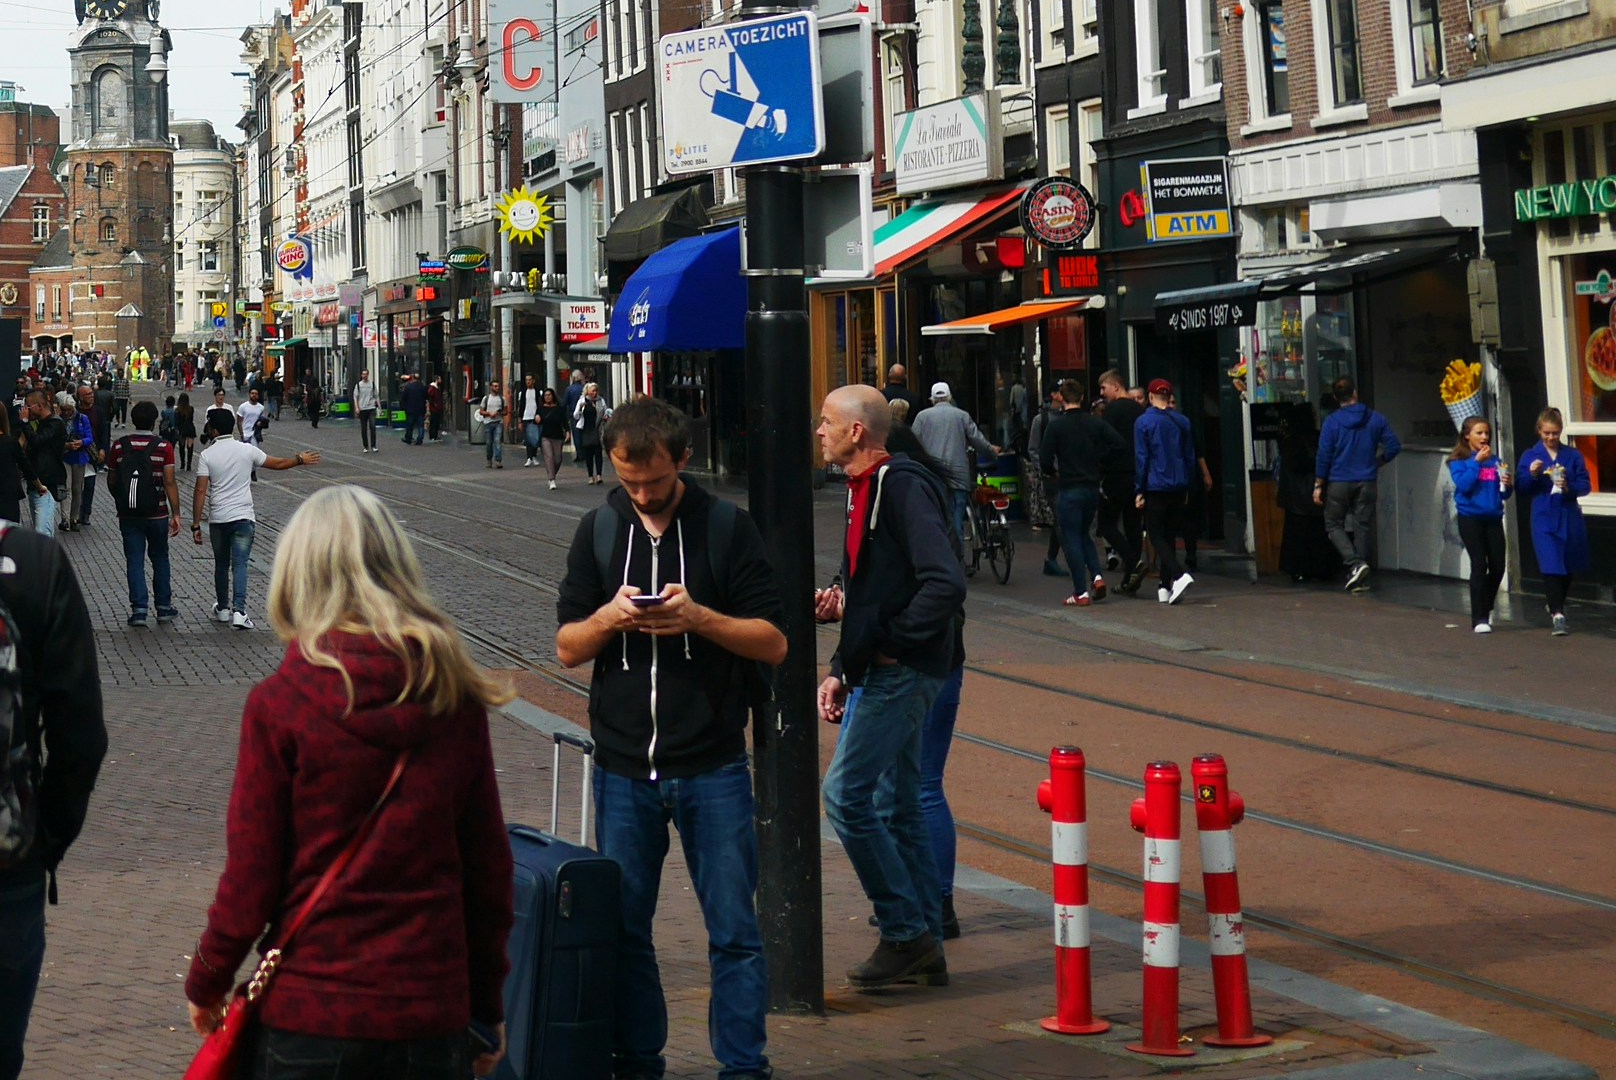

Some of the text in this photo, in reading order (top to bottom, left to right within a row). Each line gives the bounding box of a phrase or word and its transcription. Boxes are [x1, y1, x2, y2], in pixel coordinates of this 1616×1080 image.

[1153, 174, 1222, 186] SIGARENMAGAZIJN
[1154, 185, 1223, 198] HET BOMMETJE
[1514, 183, 1575, 220] NEW
[1030, 204, 1087, 221] CASINO
[1169, 214, 1217, 234] ATM
[279, 245, 303, 257] BURGER
[448, 253, 486, 263] SUBWAY
[279, 251, 304, 266] KING
[1059, 256, 1098, 275] WOK
[570, 305, 596, 314] TOURS
[1180, 304, 1229, 330] SINDS 1987
[567, 321, 600, 330] TICKETS
